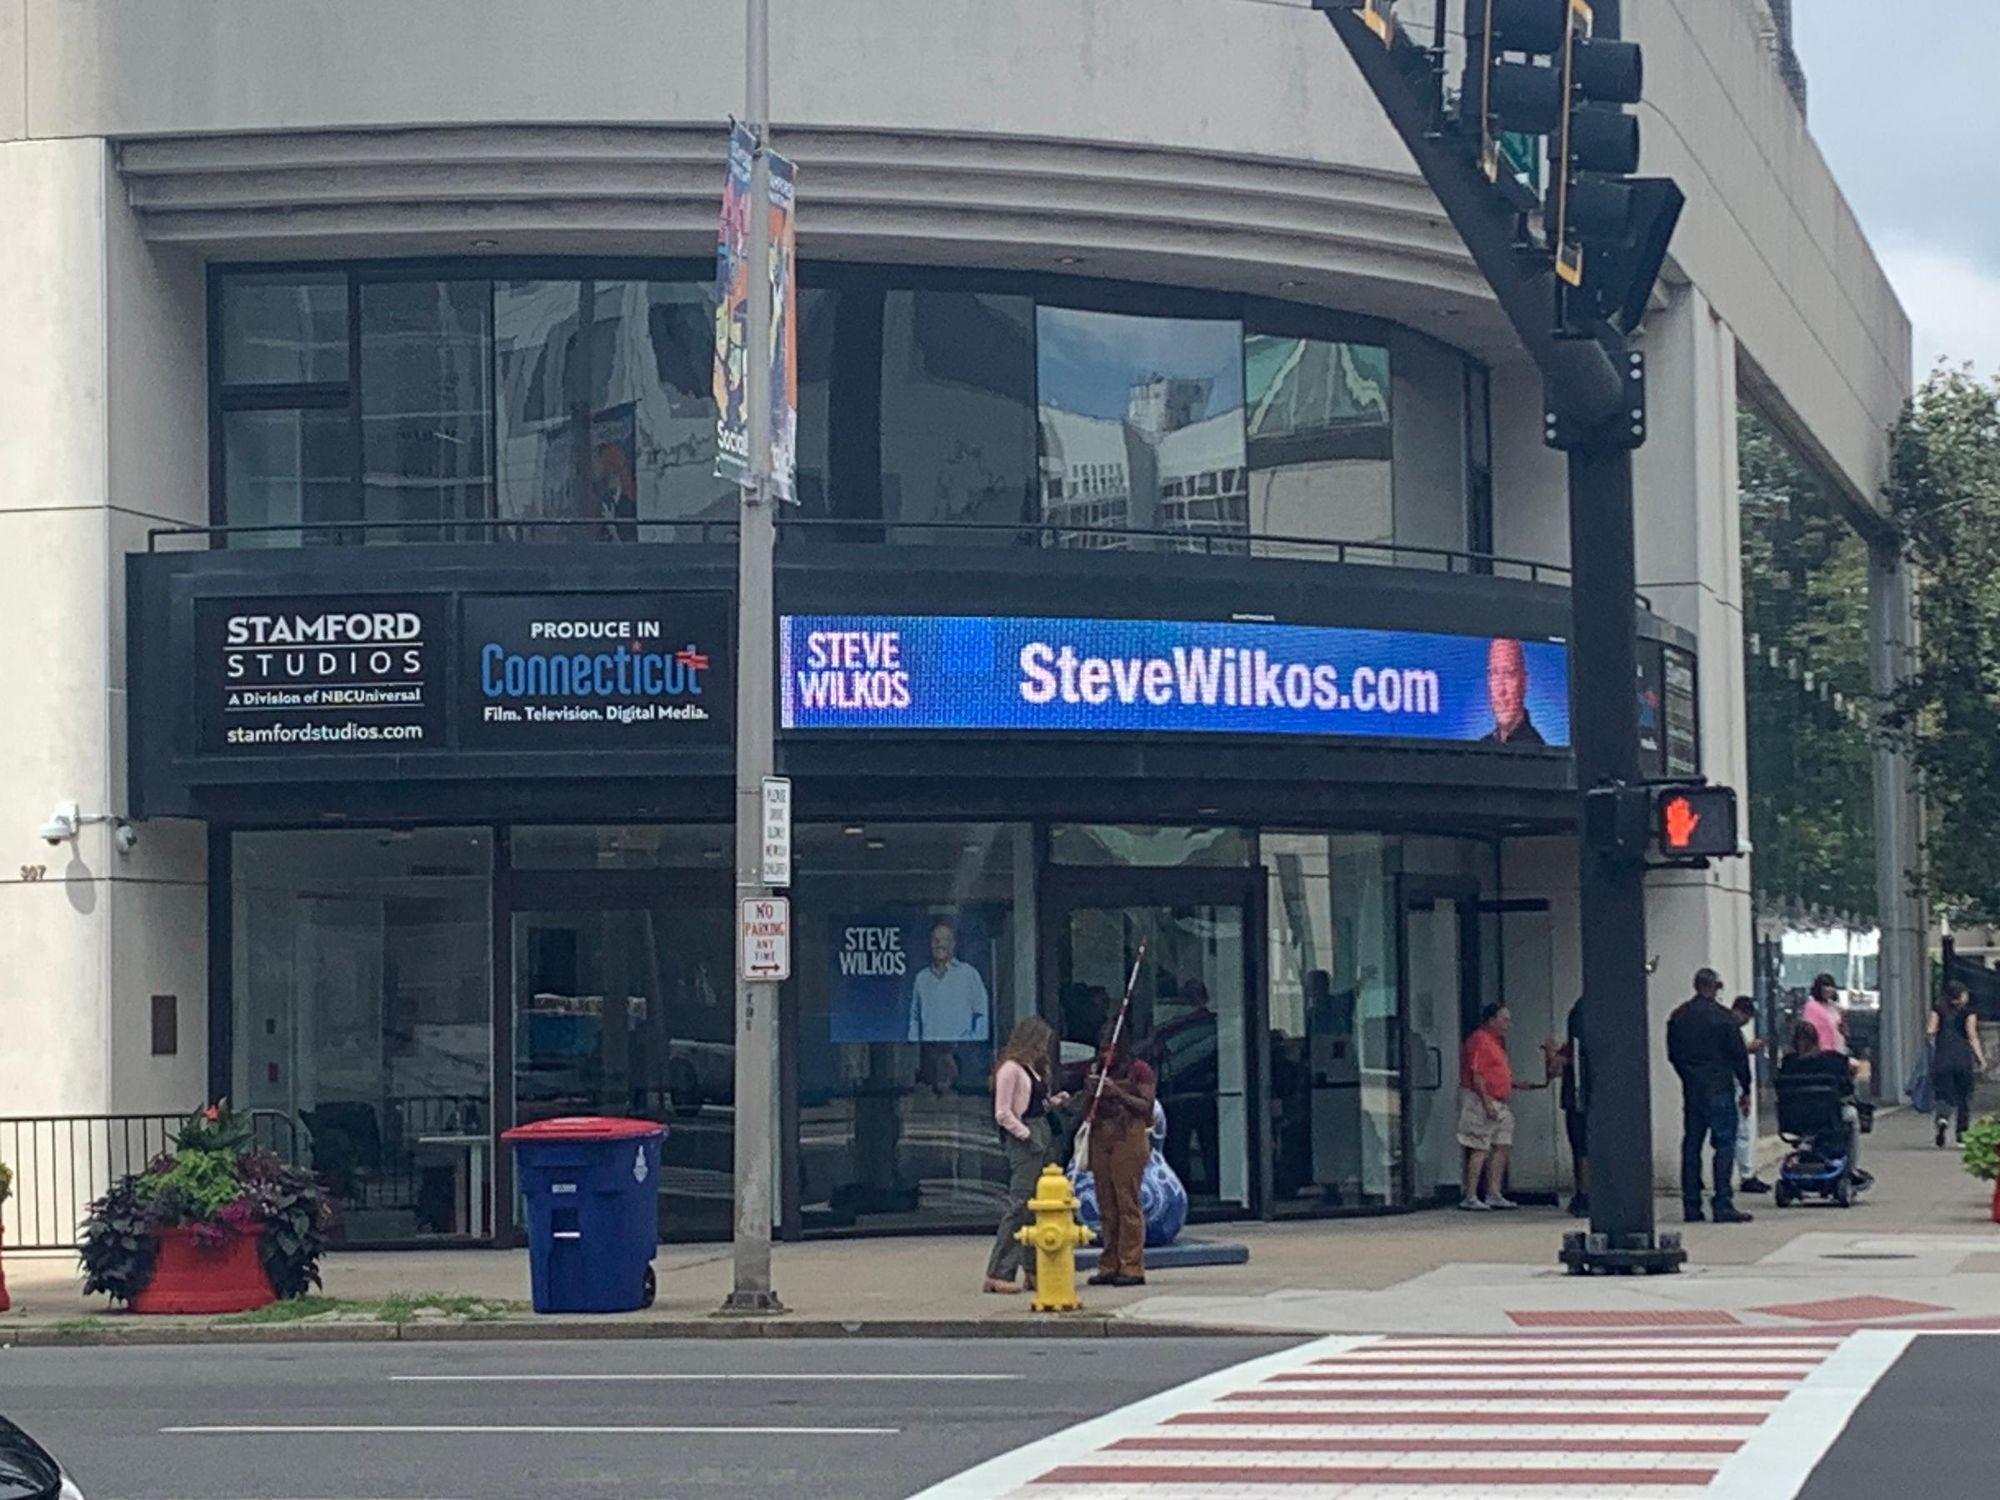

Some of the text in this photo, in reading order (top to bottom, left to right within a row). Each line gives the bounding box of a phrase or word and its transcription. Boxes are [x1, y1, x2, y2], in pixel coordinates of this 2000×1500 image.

[227, 613, 421, 643] STAMFORD
[530, 621, 660, 638] PRODUCE IN
[807, 631, 900, 669] STEVE
[227, 650, 421, 677] STUDIOS
[481, 642, 708, 697] Connecticut
[798, 670, 911, 709] WILKOS
[1019, 642, 1440, 714] SteveWilkos.com
[228, 688, 421, 706] A Division of NBCUniversal
[484, 704, 709, 724] Film. Television. Digital Media.
[227, 722, 423, 743] stamfordstudios.com
[756, 903, 773, 919] NO
[744, 922, 784, 936] PARKING
[845, 927, 901, 951] STEVE
[839, 951, 906, 975] WILKOS
